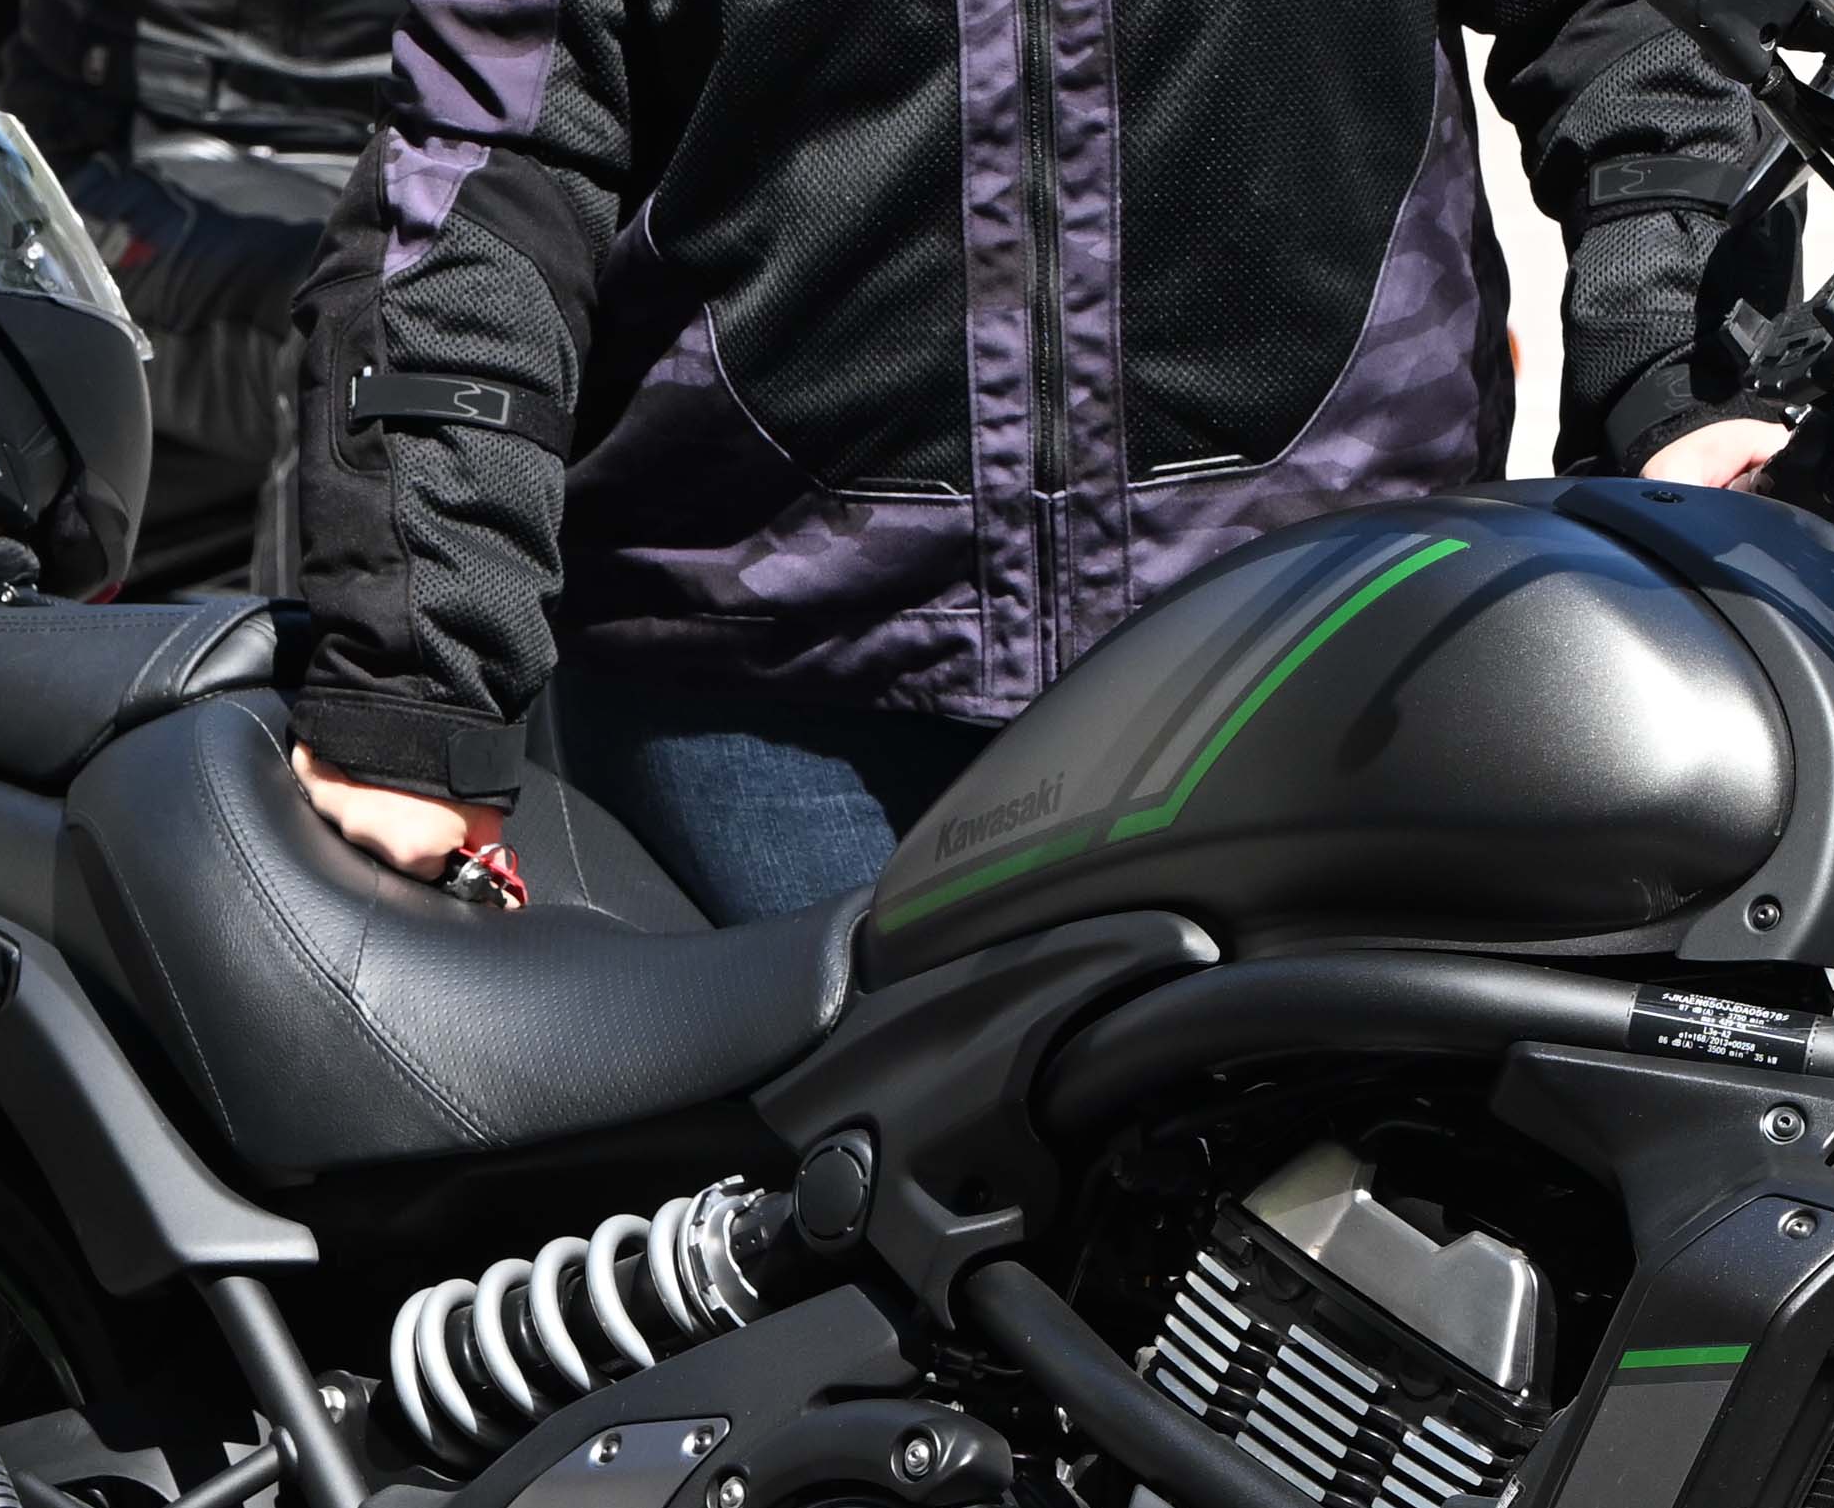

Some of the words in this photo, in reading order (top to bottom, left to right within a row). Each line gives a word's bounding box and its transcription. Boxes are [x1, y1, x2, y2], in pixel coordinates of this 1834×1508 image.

[934, 771, 1065, 862] Kawasaki
[1707, 1044, 1726, 1055] 3500
[1754, 1053, 1764, 1062] 35
